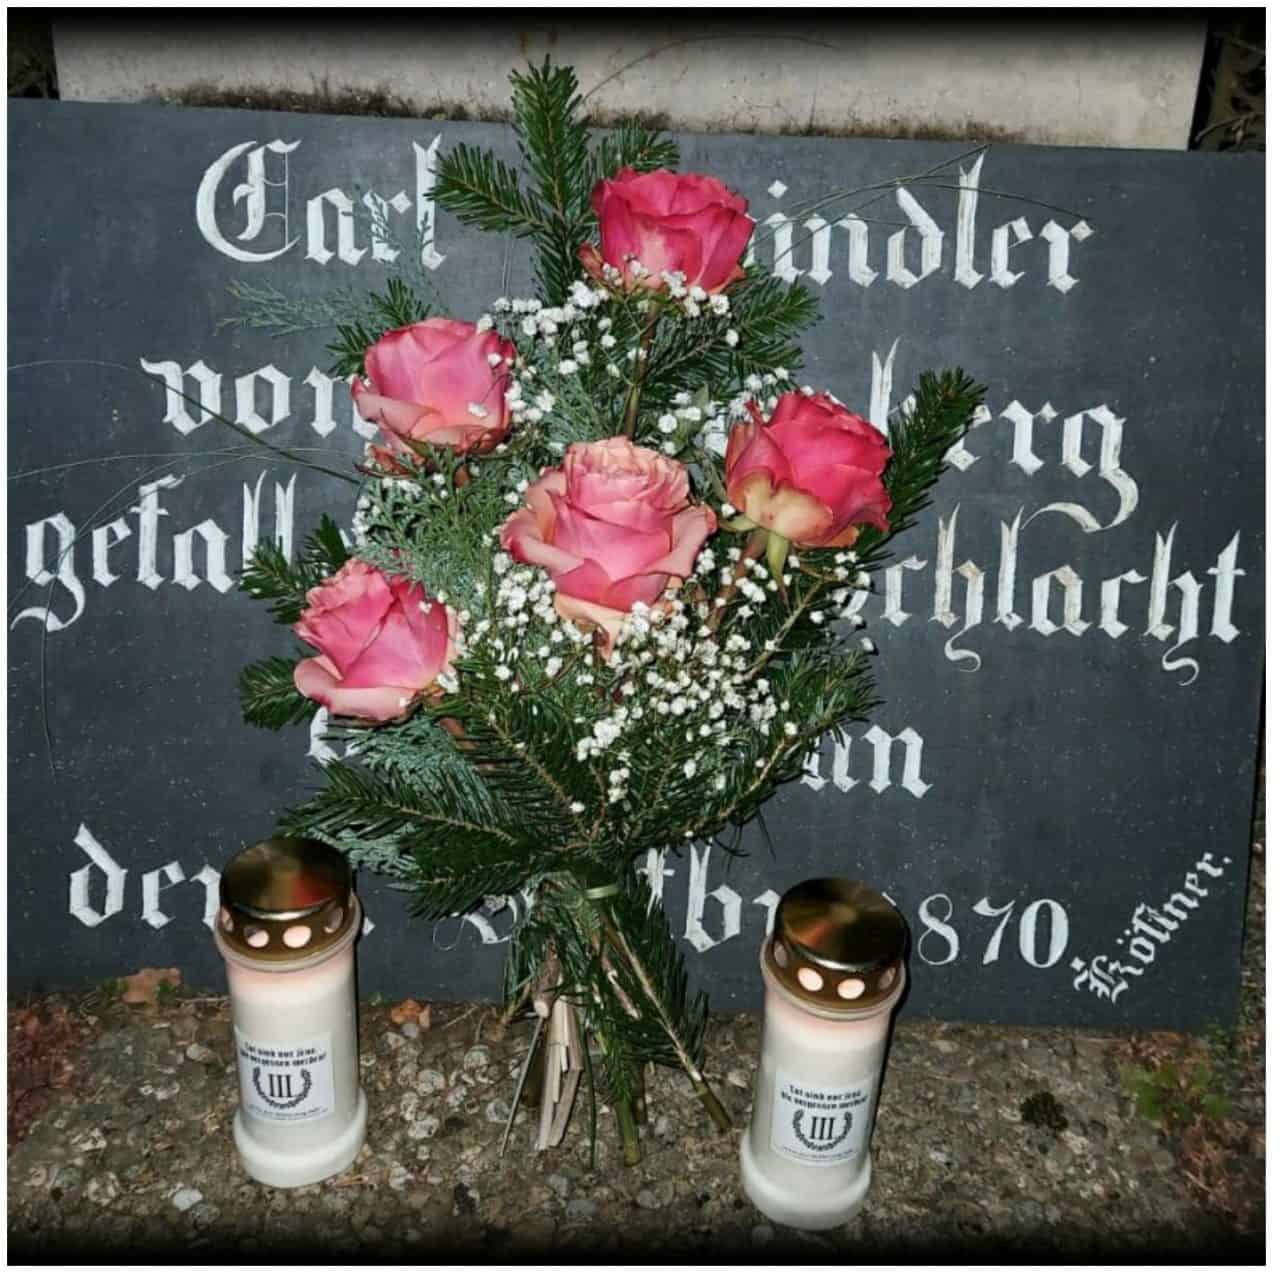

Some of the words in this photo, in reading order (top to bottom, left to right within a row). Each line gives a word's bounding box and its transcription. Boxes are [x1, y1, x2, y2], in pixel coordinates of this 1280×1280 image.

[196, 133, 447, 270] Carl
[858, 503, 1246, 686] chlacht
[917, 893, 1070, 970] 870
